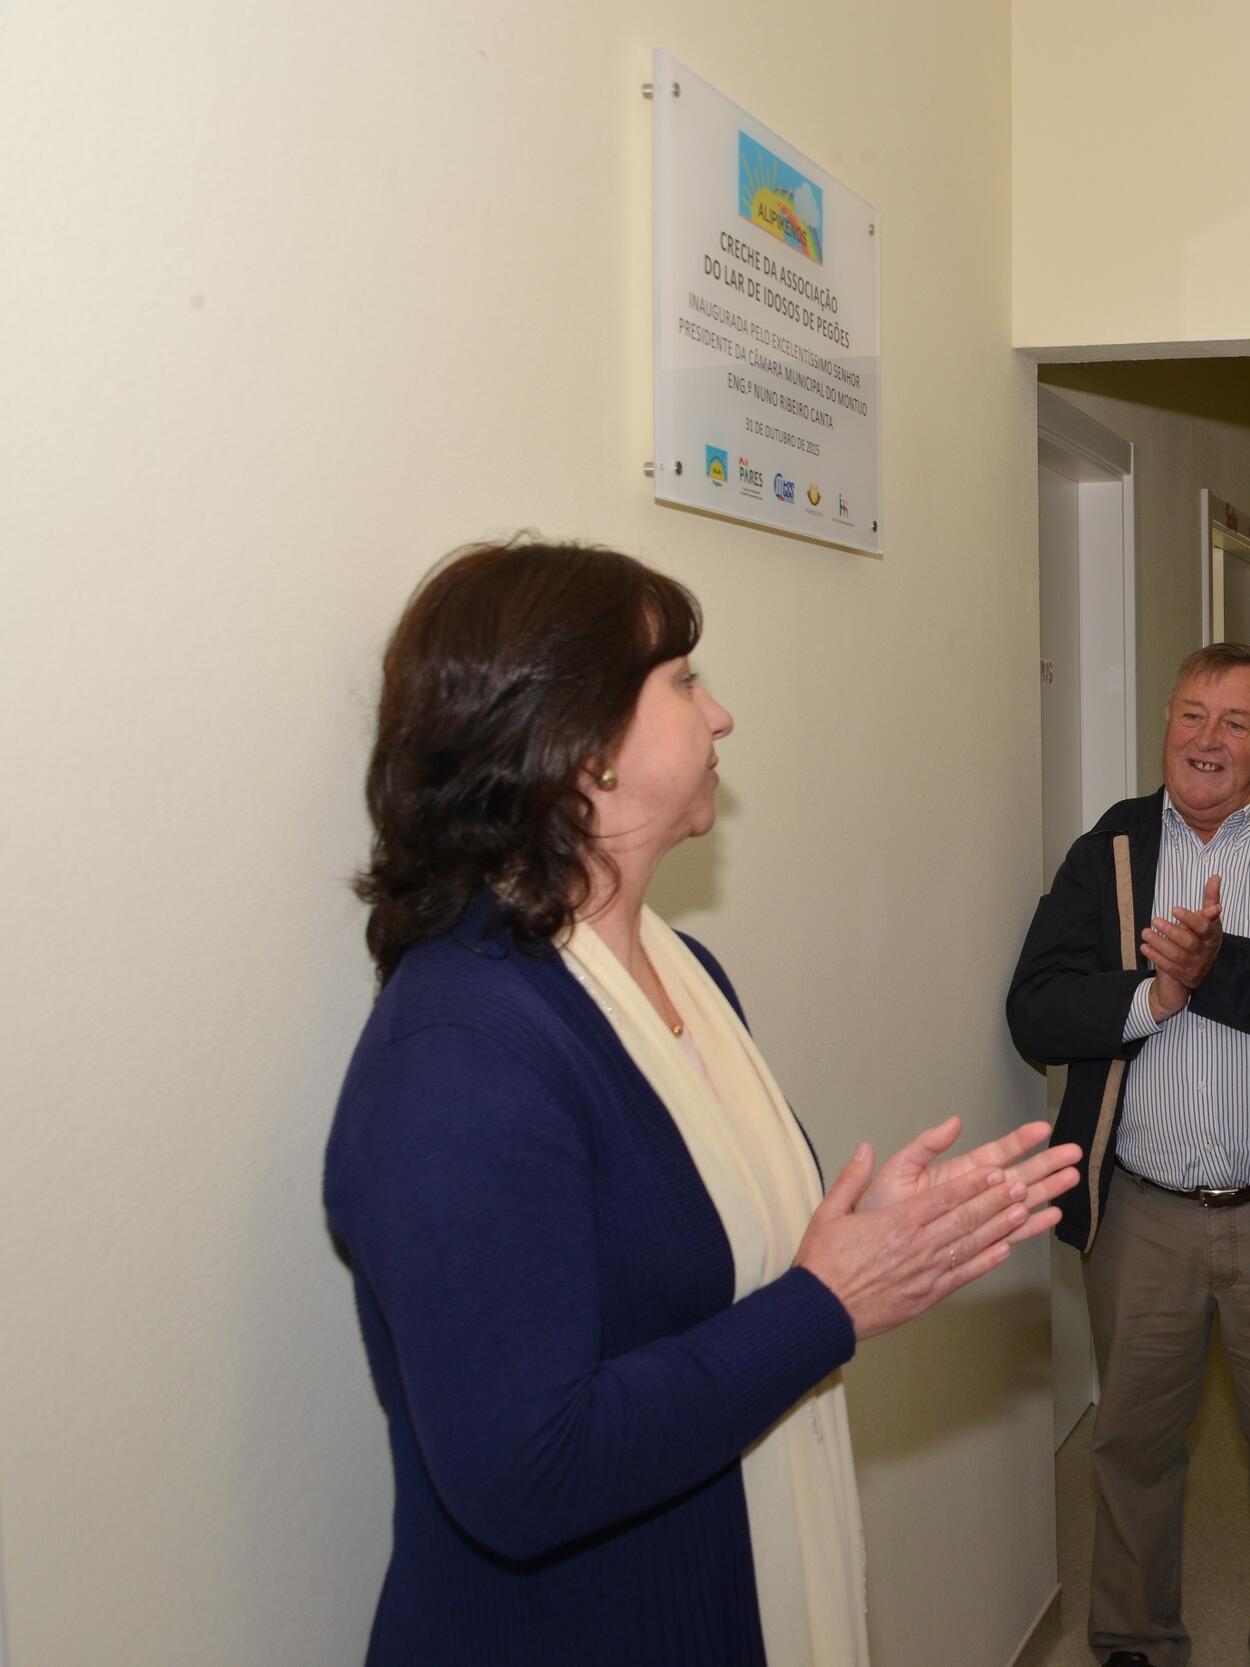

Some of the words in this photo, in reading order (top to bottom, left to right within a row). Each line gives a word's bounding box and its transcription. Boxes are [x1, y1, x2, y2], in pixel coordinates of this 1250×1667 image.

[704, 253, 721, 280] DO
[724, 265, 745, 294] LAR
[747, 278, 761, 302] DE
[763, 286, 801, 323] IDOSOS
[802, 307, 815, 331] DE
[817, 315, 850, 349] PEGÕES
[720, 231, 760, 271] CRECHE
[763, 255, 778, 281] DA
[780, 266, 838, 314] ASSOCIAÇÃO
[679, 317, 734, 357] PRESIDENTE
[735, 342, 747, 362] DA
[749, 347, 783, 379] CÂMARA
[784, 365, 825, 398] MUNICIPAL
[826, 385, 837, 403] DO
[688, 291, 749, 336] INAUGURADA
[750, 321, 770, 346] PELO
[772, 333, 832, 376] EXCELENTÍSSIMO
[833, 363, 861, 391] SENHOR
[745, 417, 754, 433] 31
[755, 421, 764, 436] DE
[765, 425, 797, 448] OUTUBRO
[797, 436, 806, 452] DE
[806, 440, 820, 457] 2015
[754, 383, 778, 407] NUNO
[780, 394, 810, 420] RIBEIRO
[811, 407, 834, 431] CANTA
[740, 466, 764, 488] PARES
